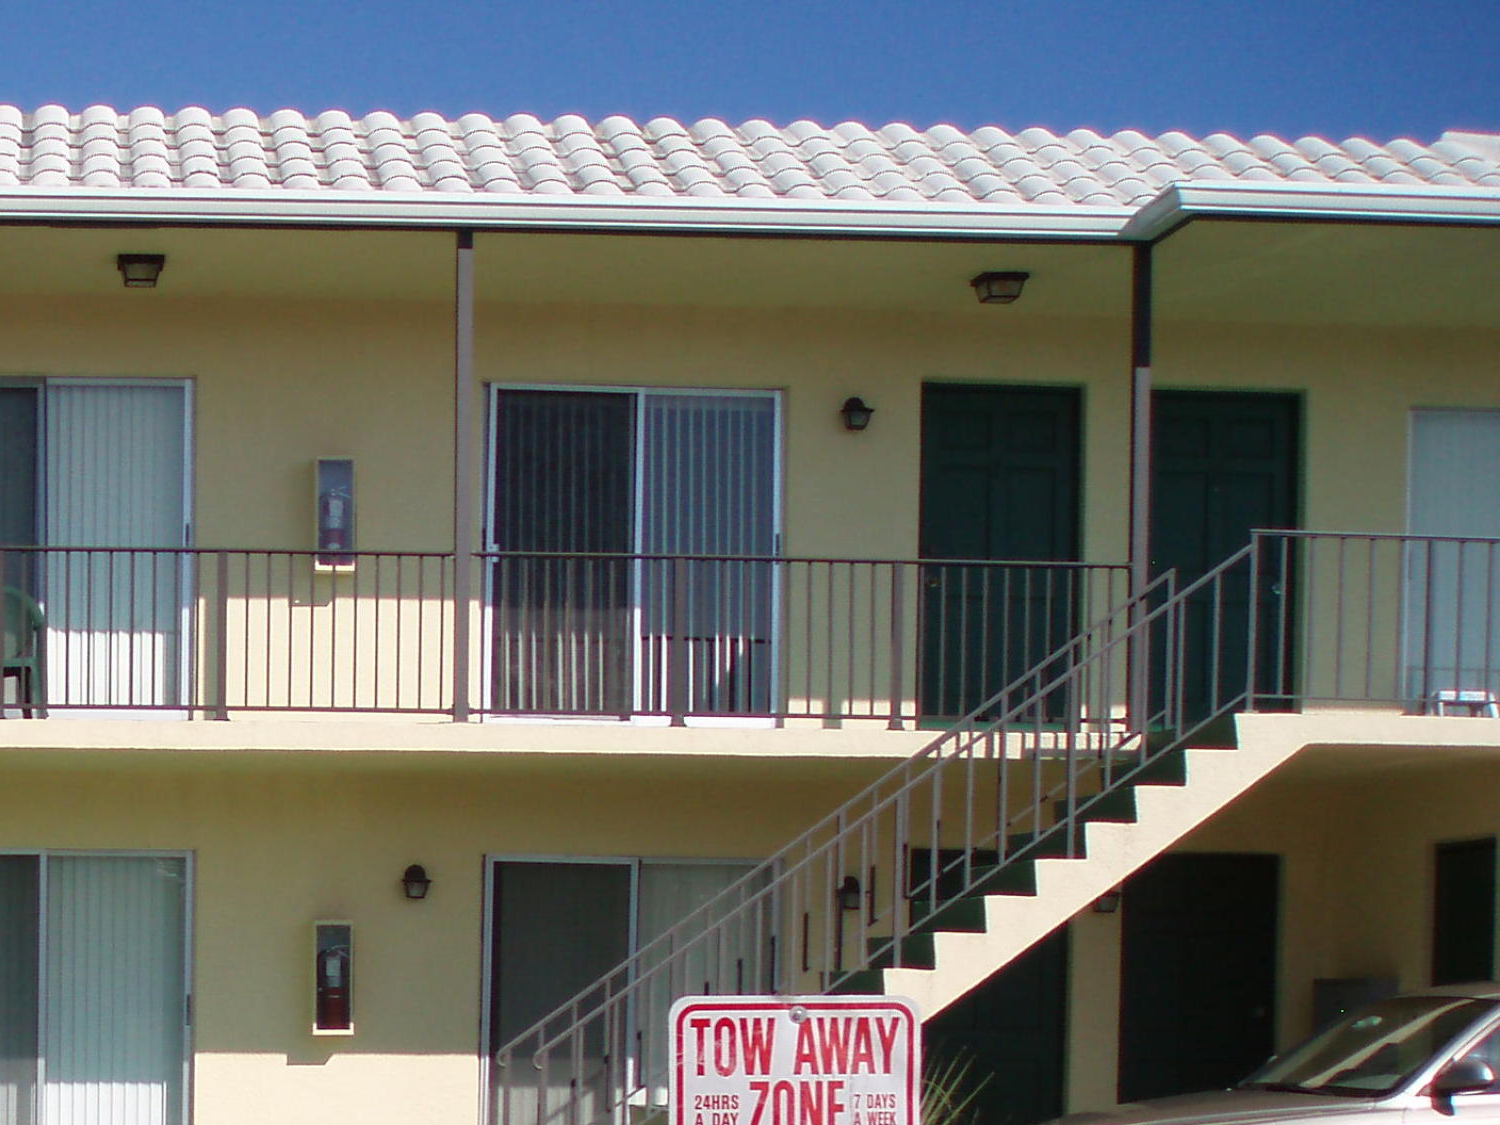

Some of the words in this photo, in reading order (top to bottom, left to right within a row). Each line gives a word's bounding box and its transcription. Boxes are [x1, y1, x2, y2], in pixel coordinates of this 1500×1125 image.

[690, 1018, 775, 1076] TOW
[794, 1017, 899, 1075] AWAY
[695, 1095, 739, 1109] 24HRS
[854, 1094, 860, 1109] 7
[867, 1094, 896, 1109] DAYS
[854, 1112, 861, 1125] A
[867, 1112, 896, 1125] WEEK
